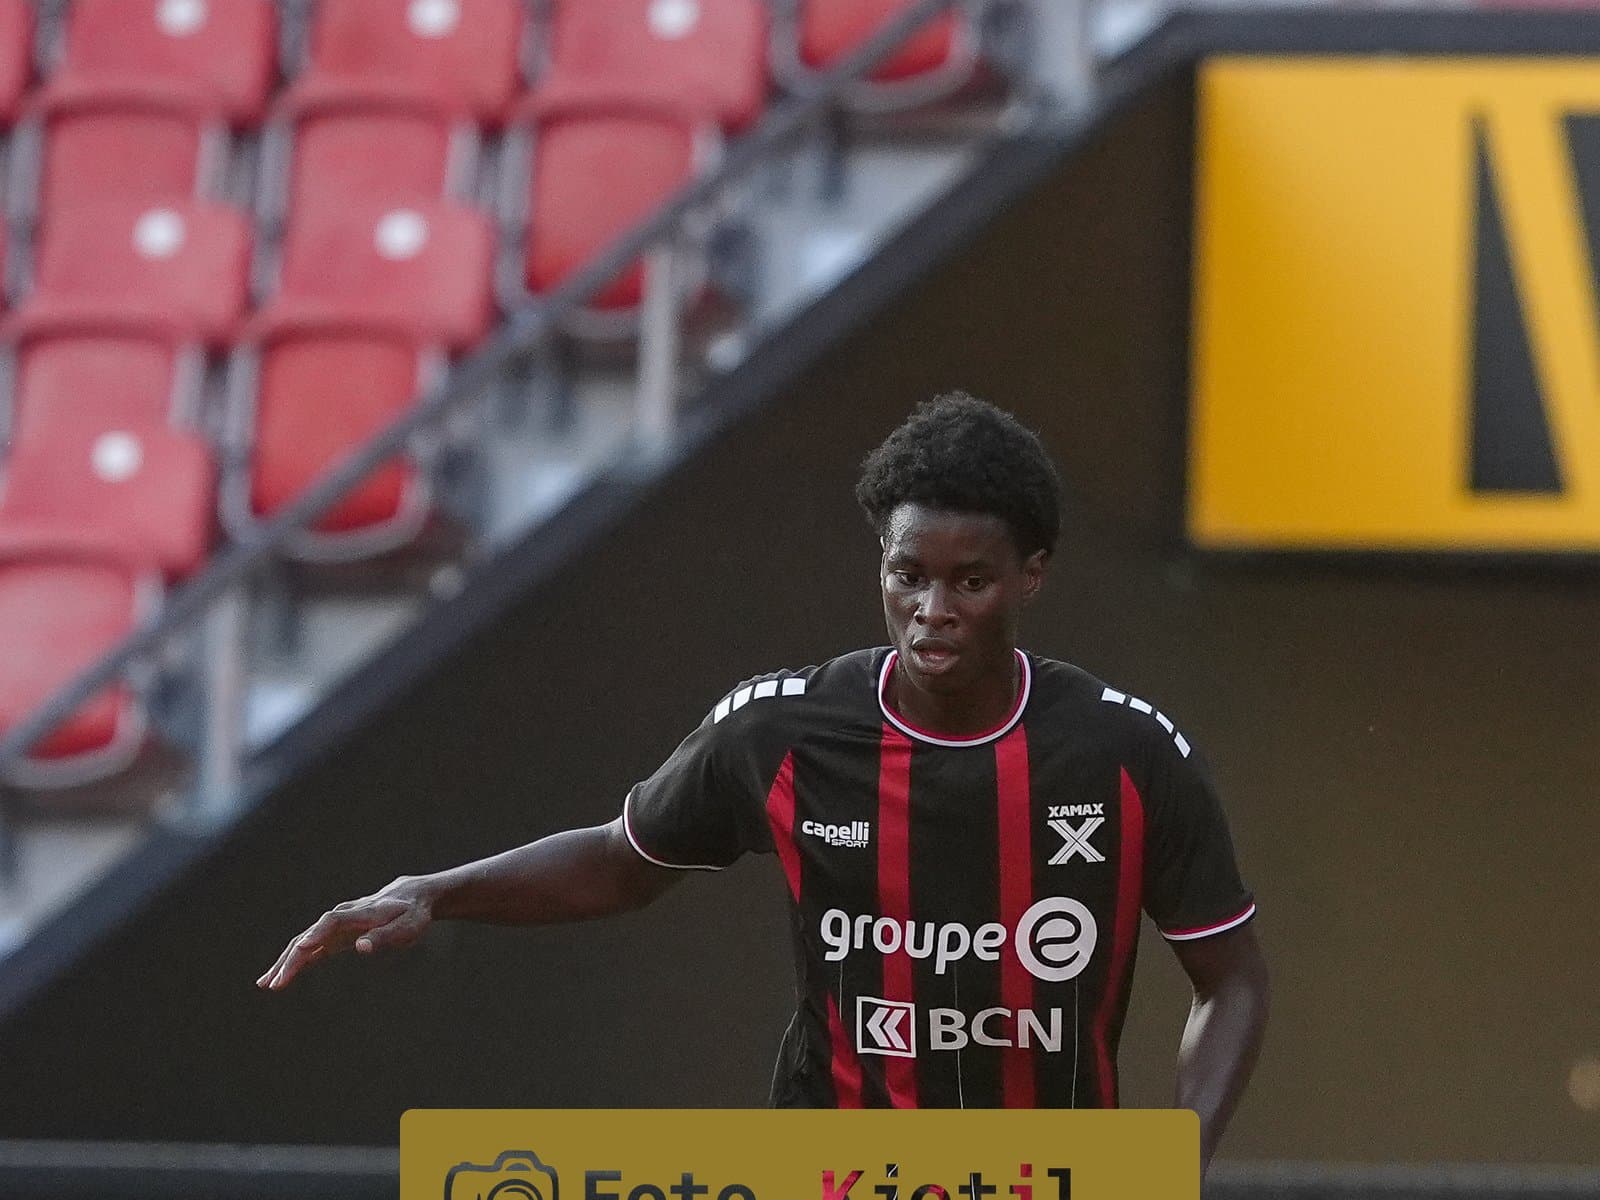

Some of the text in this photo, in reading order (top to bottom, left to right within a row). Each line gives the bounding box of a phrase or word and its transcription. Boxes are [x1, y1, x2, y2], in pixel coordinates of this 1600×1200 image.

[1048, 803, 1104, 818] XAMAX
[802, 821, 870, 844] capelli
[831, 838, 868, 848] SPORT
[820, 908, 1007, 975] groupe
[930, 1007, 1062, 1052] BCN
